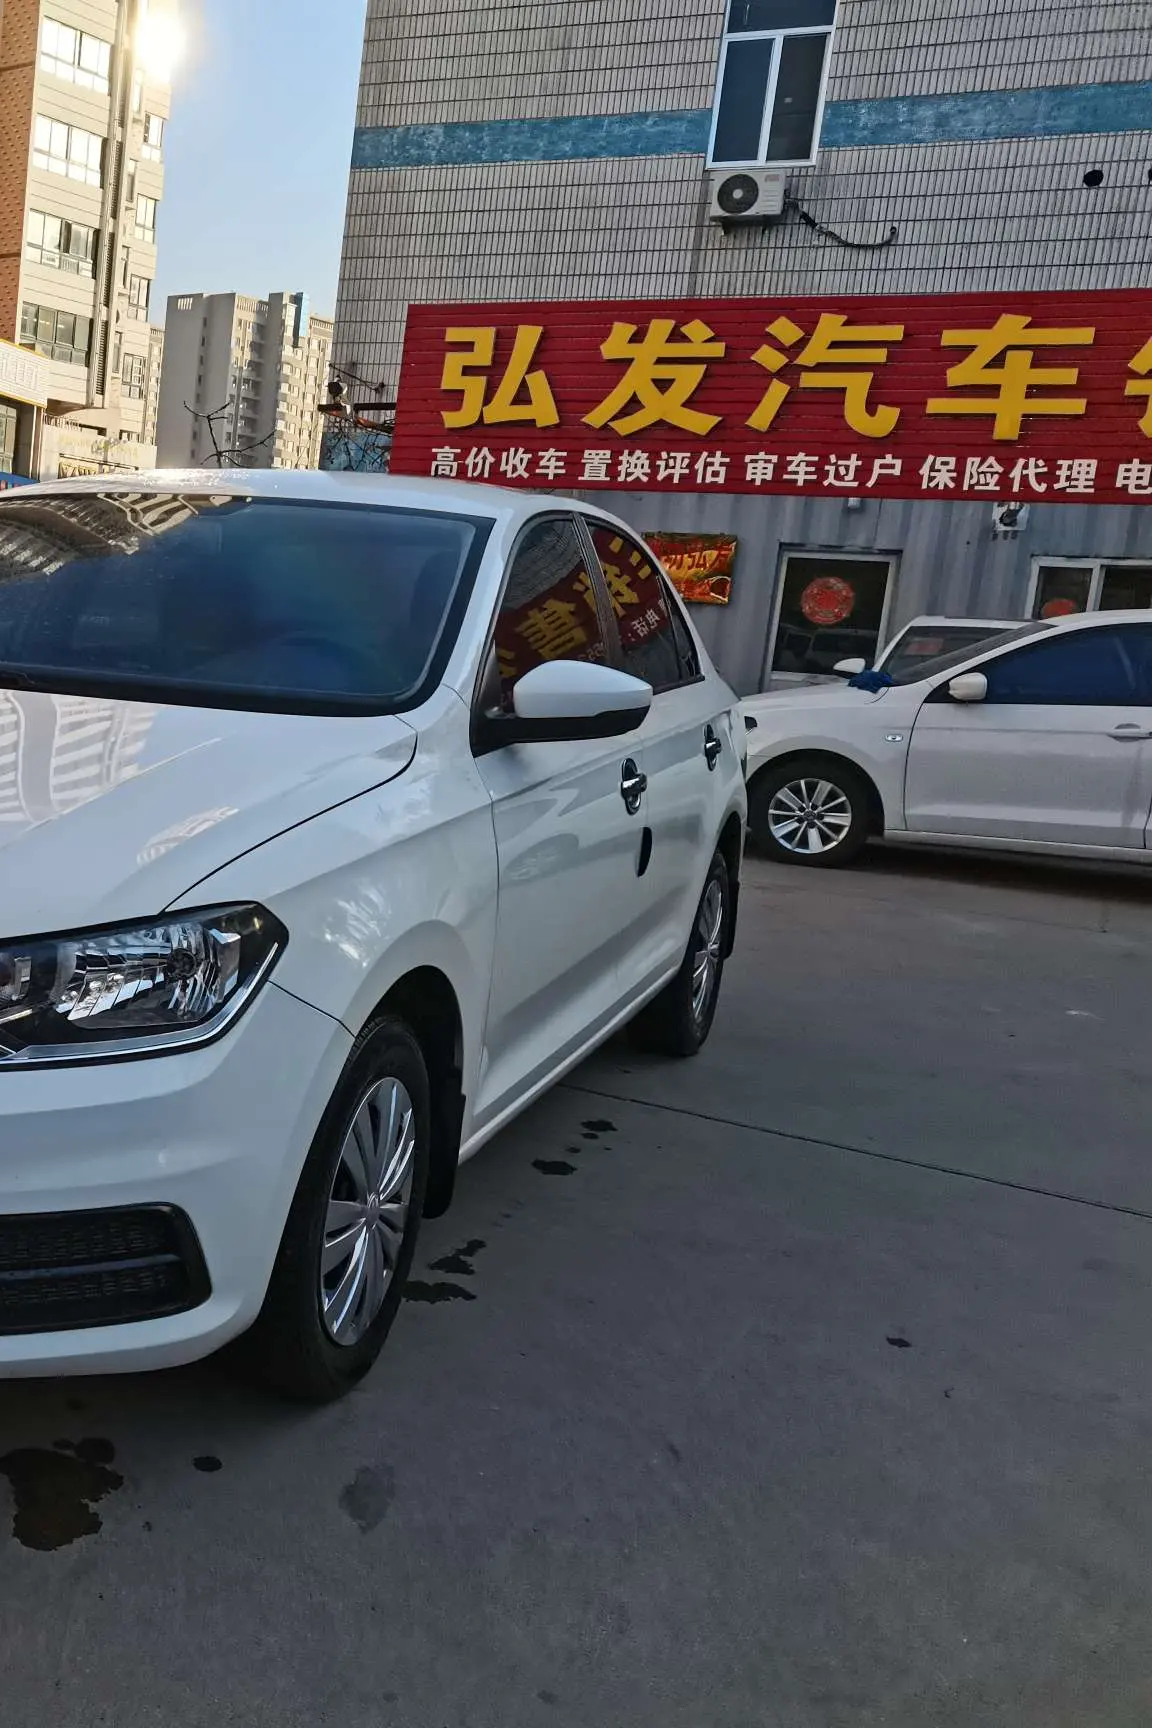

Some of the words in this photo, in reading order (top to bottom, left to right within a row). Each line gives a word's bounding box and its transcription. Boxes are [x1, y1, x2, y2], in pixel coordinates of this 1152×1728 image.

[429, 447, 568, 480] 高价收车
[577, 447, 730, 485] 置换评估
[744, 451, 903, 489] 审车过户
[918, 454, 1098, 494] 保险代理
